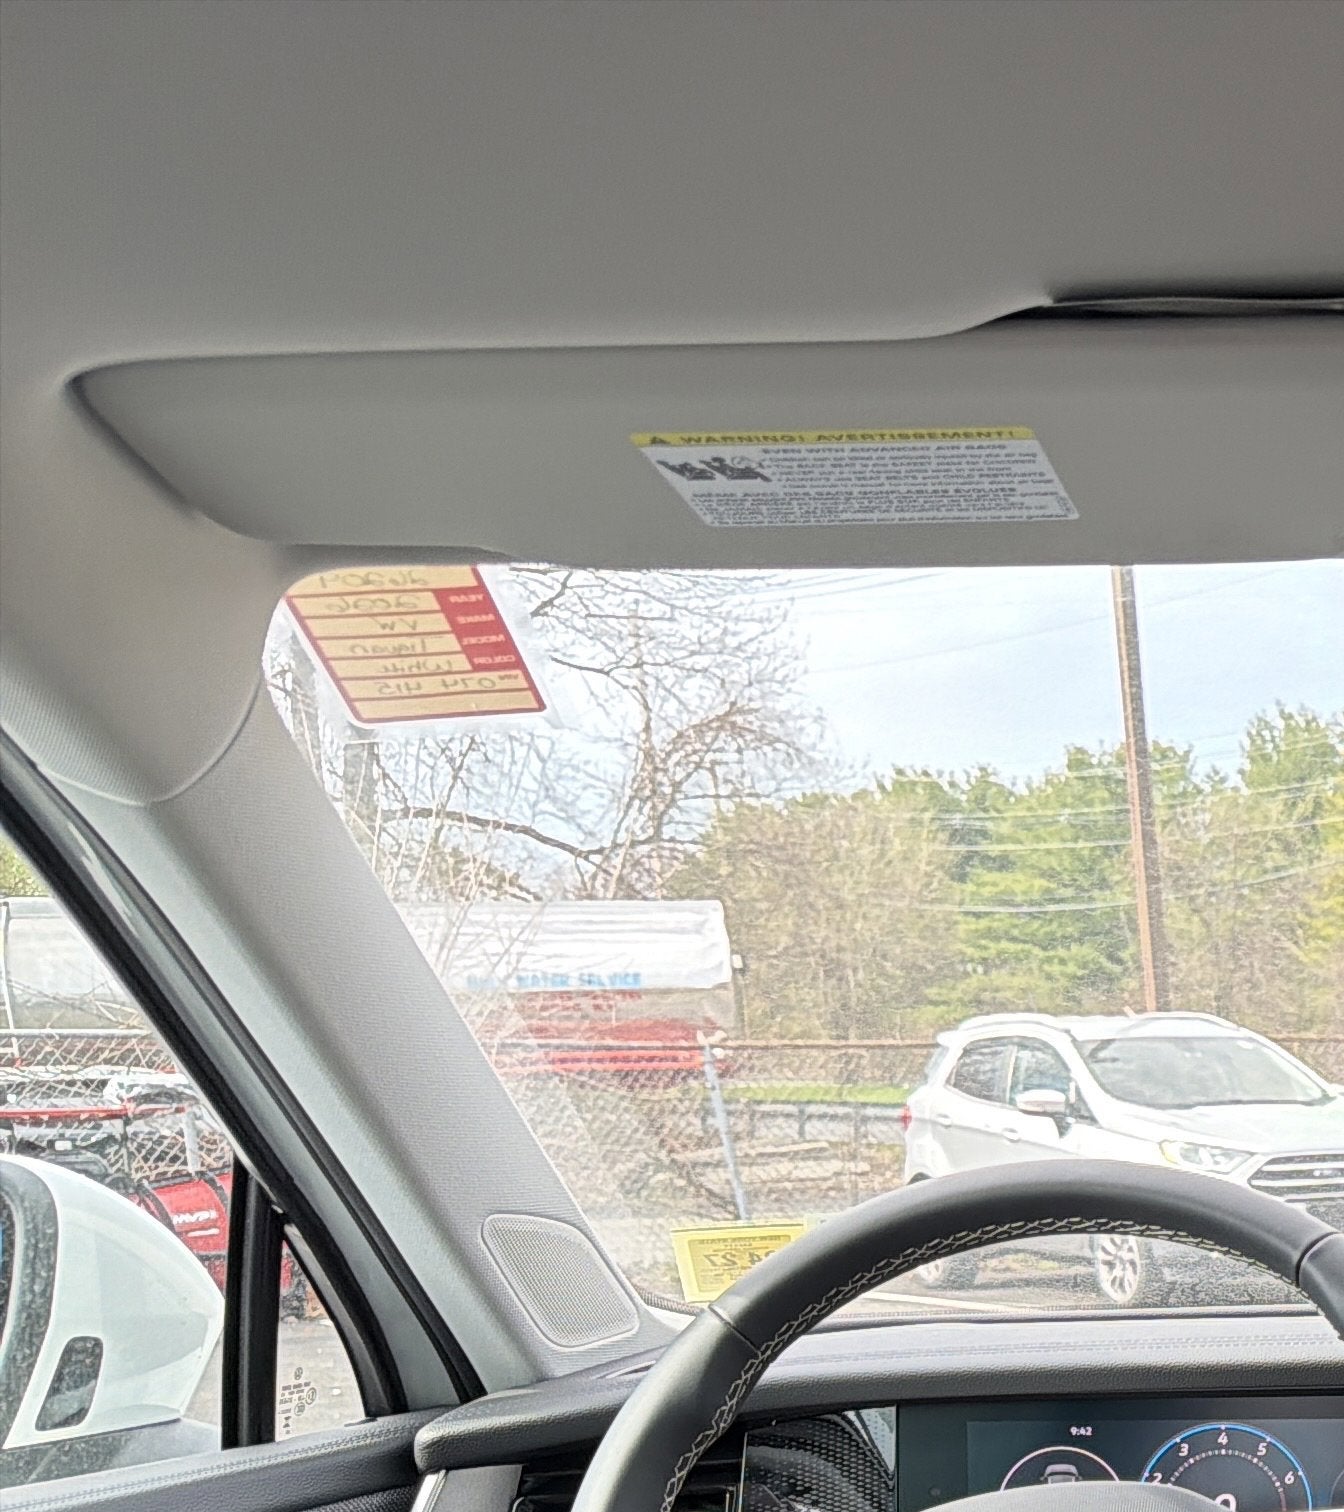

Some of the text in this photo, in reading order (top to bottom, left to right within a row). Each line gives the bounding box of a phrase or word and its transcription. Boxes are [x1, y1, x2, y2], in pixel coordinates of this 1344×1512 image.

[1069, 1426, 1093, 1437] 9:42
[1217, 1432, 1229, 1446] 4
[1178, 1443, 1190, 1457] 3
[1256, 1443, 1268, 1457] 5
[1283, 1471, 1296, 1486] 6
